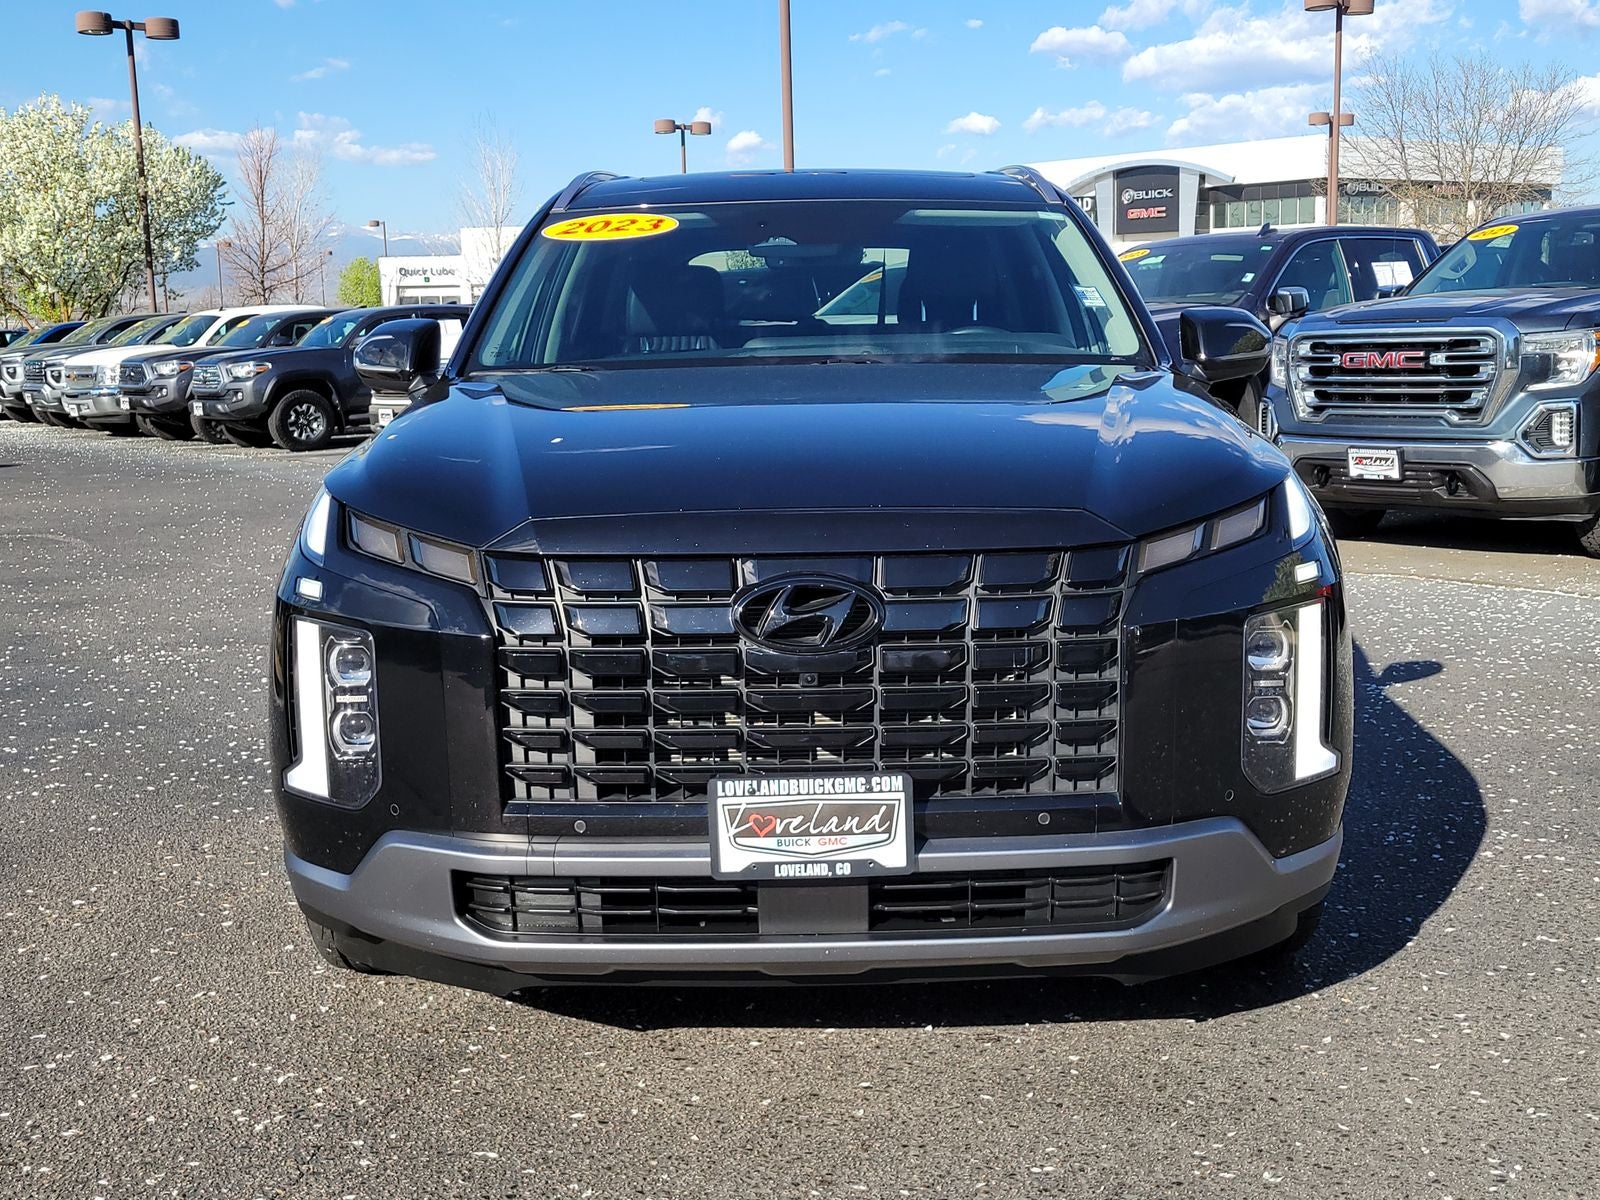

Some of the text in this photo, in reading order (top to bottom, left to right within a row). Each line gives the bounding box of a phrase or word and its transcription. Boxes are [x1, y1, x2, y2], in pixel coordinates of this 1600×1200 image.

[1133, 189, 1174, 201] BUICK
[1127, 206, 1167, 219] GMC
[555, 219, 666, 235] 2023
[399, 267, 455, 278] Quick Lube
[1342, 351, 1425, 368] GMC
[717, 775, 903, 797] LOVELANDBUICKGMC.COM
[777, 836, 848, 847] BUICK GMC
[774, 862, 851, 877] LOVELAND, CO
